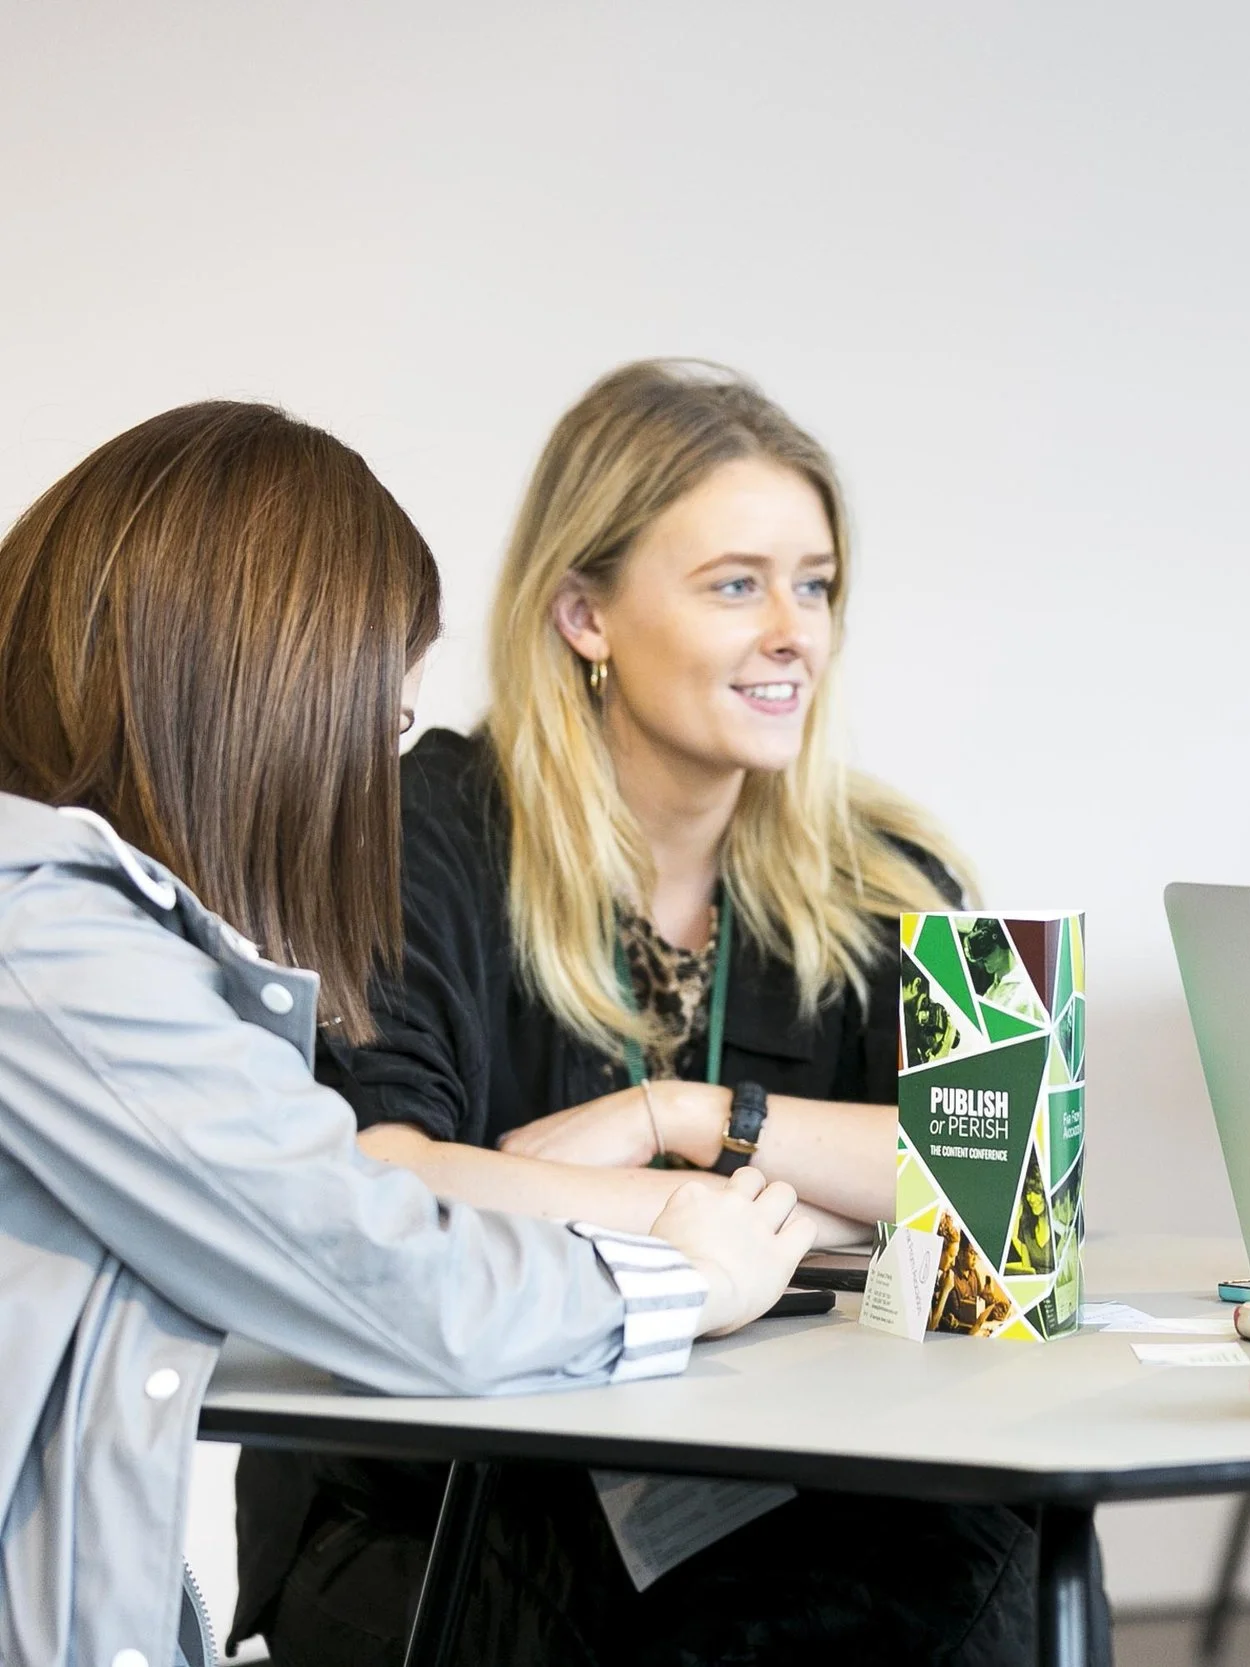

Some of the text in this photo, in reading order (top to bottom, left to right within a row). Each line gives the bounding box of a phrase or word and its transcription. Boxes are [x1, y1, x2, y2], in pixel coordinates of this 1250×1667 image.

[930, 1086, 1009, 1119] PUBLISH
[929, 1115, 1009, 1140] or PERISH
[930, 1144, 1008, 1162] THE CONTENT CONFERENCE
